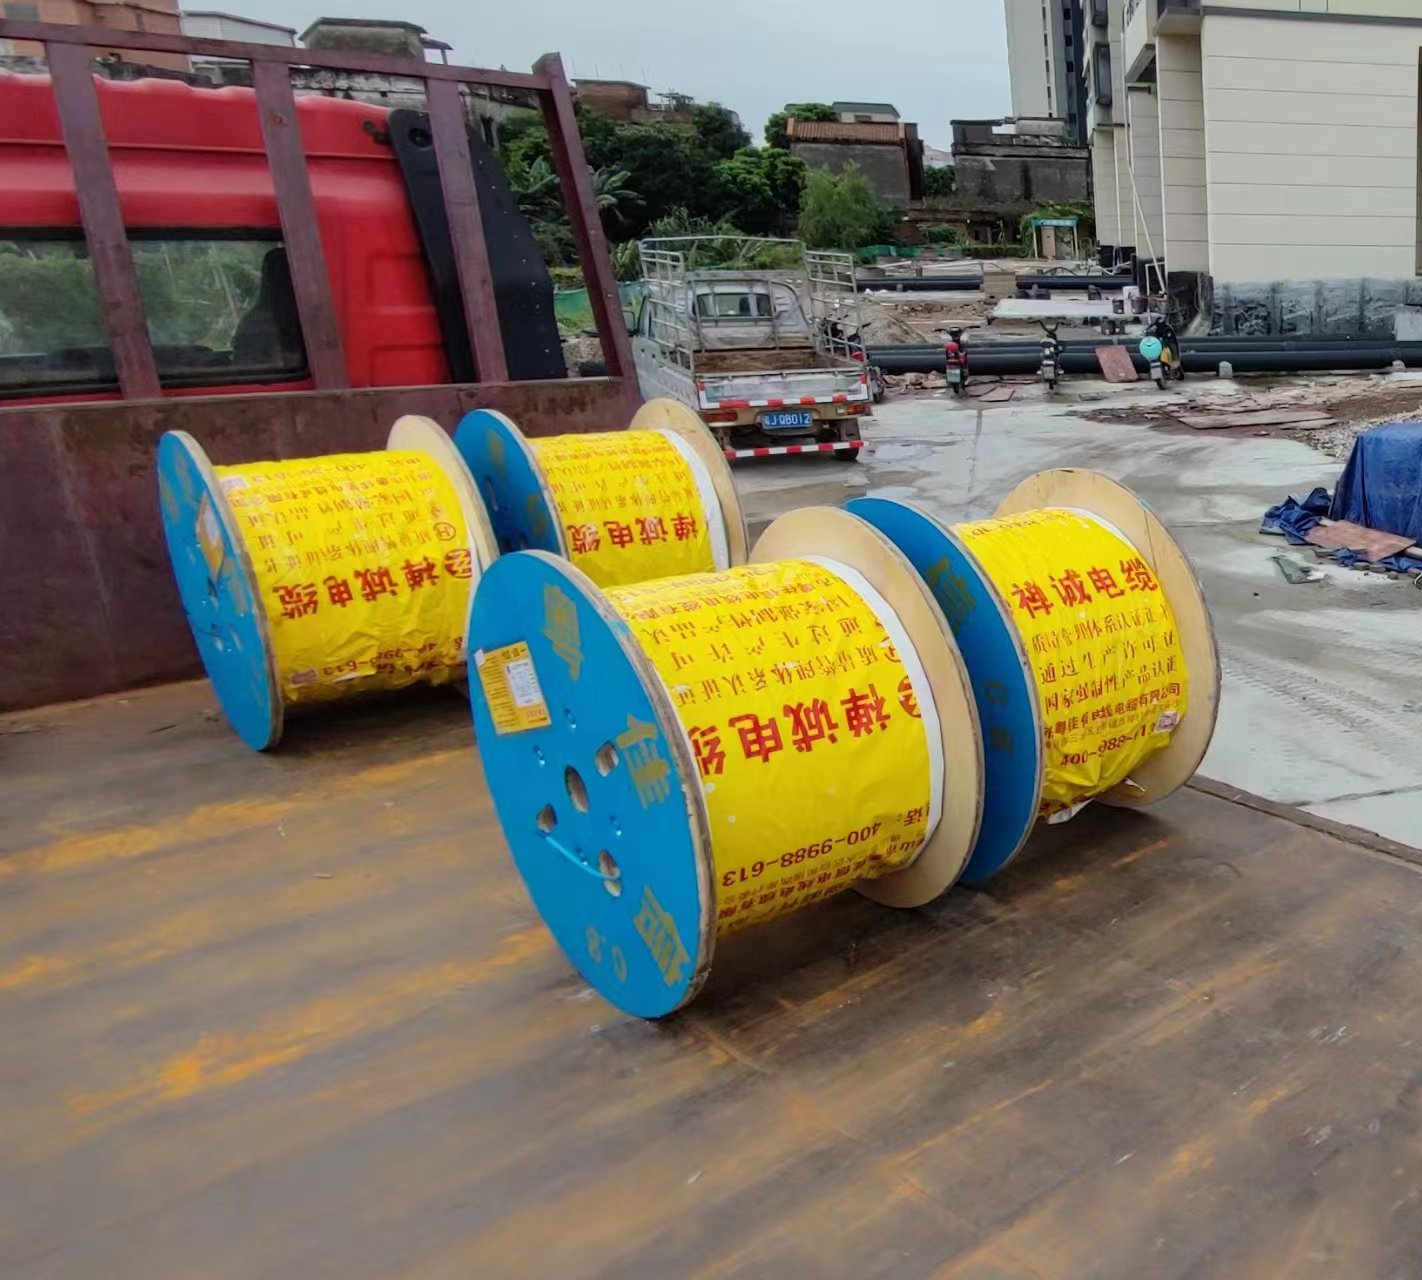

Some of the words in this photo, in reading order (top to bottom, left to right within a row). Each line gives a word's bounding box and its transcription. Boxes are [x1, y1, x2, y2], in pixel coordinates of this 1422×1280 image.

[567, 511, 698, 554] 禅诚电缆
[272, 557, 440, 619] 禅诚电缆
[1010, 558, 1158, 620] 禅诚电缆
[721, 820, 883, 888] 400-9988-613
